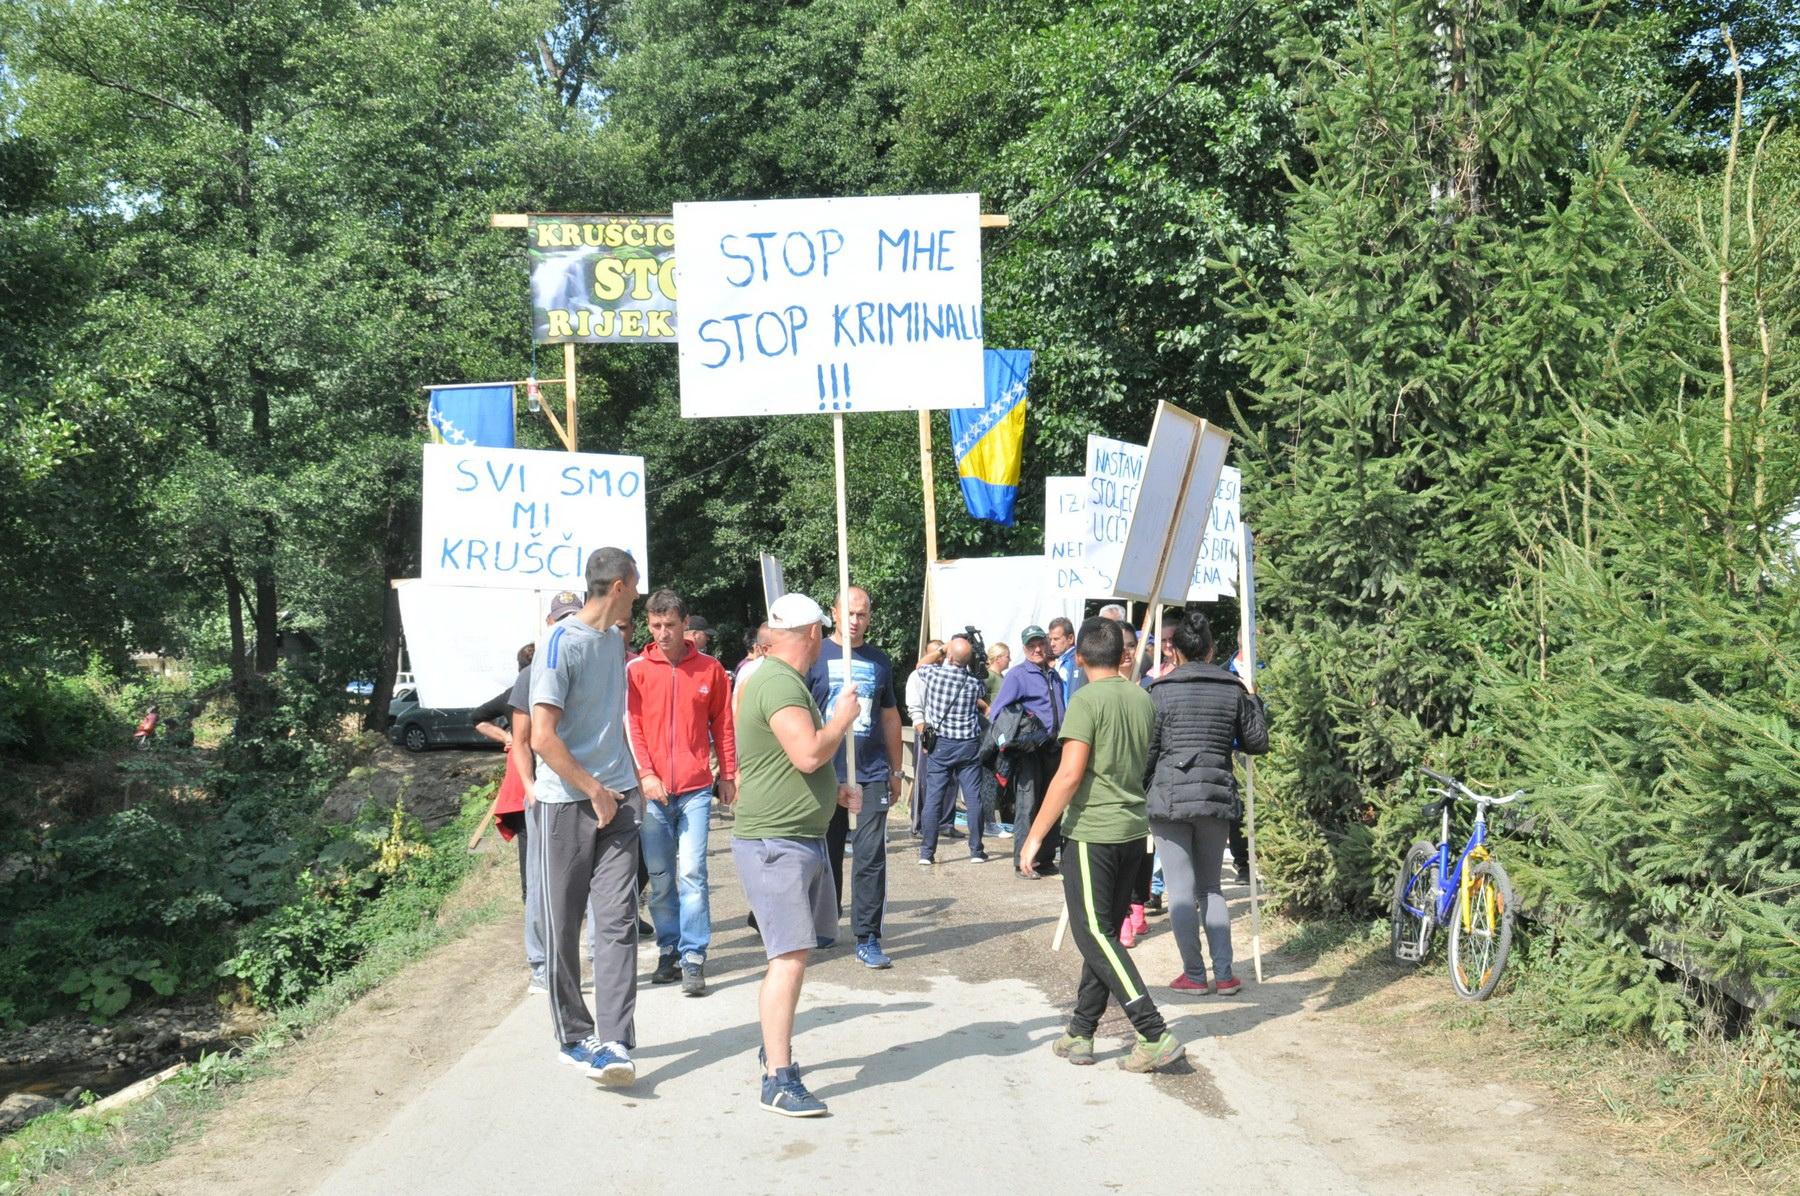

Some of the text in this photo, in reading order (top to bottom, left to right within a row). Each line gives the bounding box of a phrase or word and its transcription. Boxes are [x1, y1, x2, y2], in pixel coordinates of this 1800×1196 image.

[720, 228, 957, 287] STOP MHE
[698, 305, 808, 369] STOP
[817, 362, 852, 410] !!!
[456, 459, 640, 498] SVI SMO
[512, 501, 551, 530] MI
[440, 531, 640, 580] KRUŠČI
